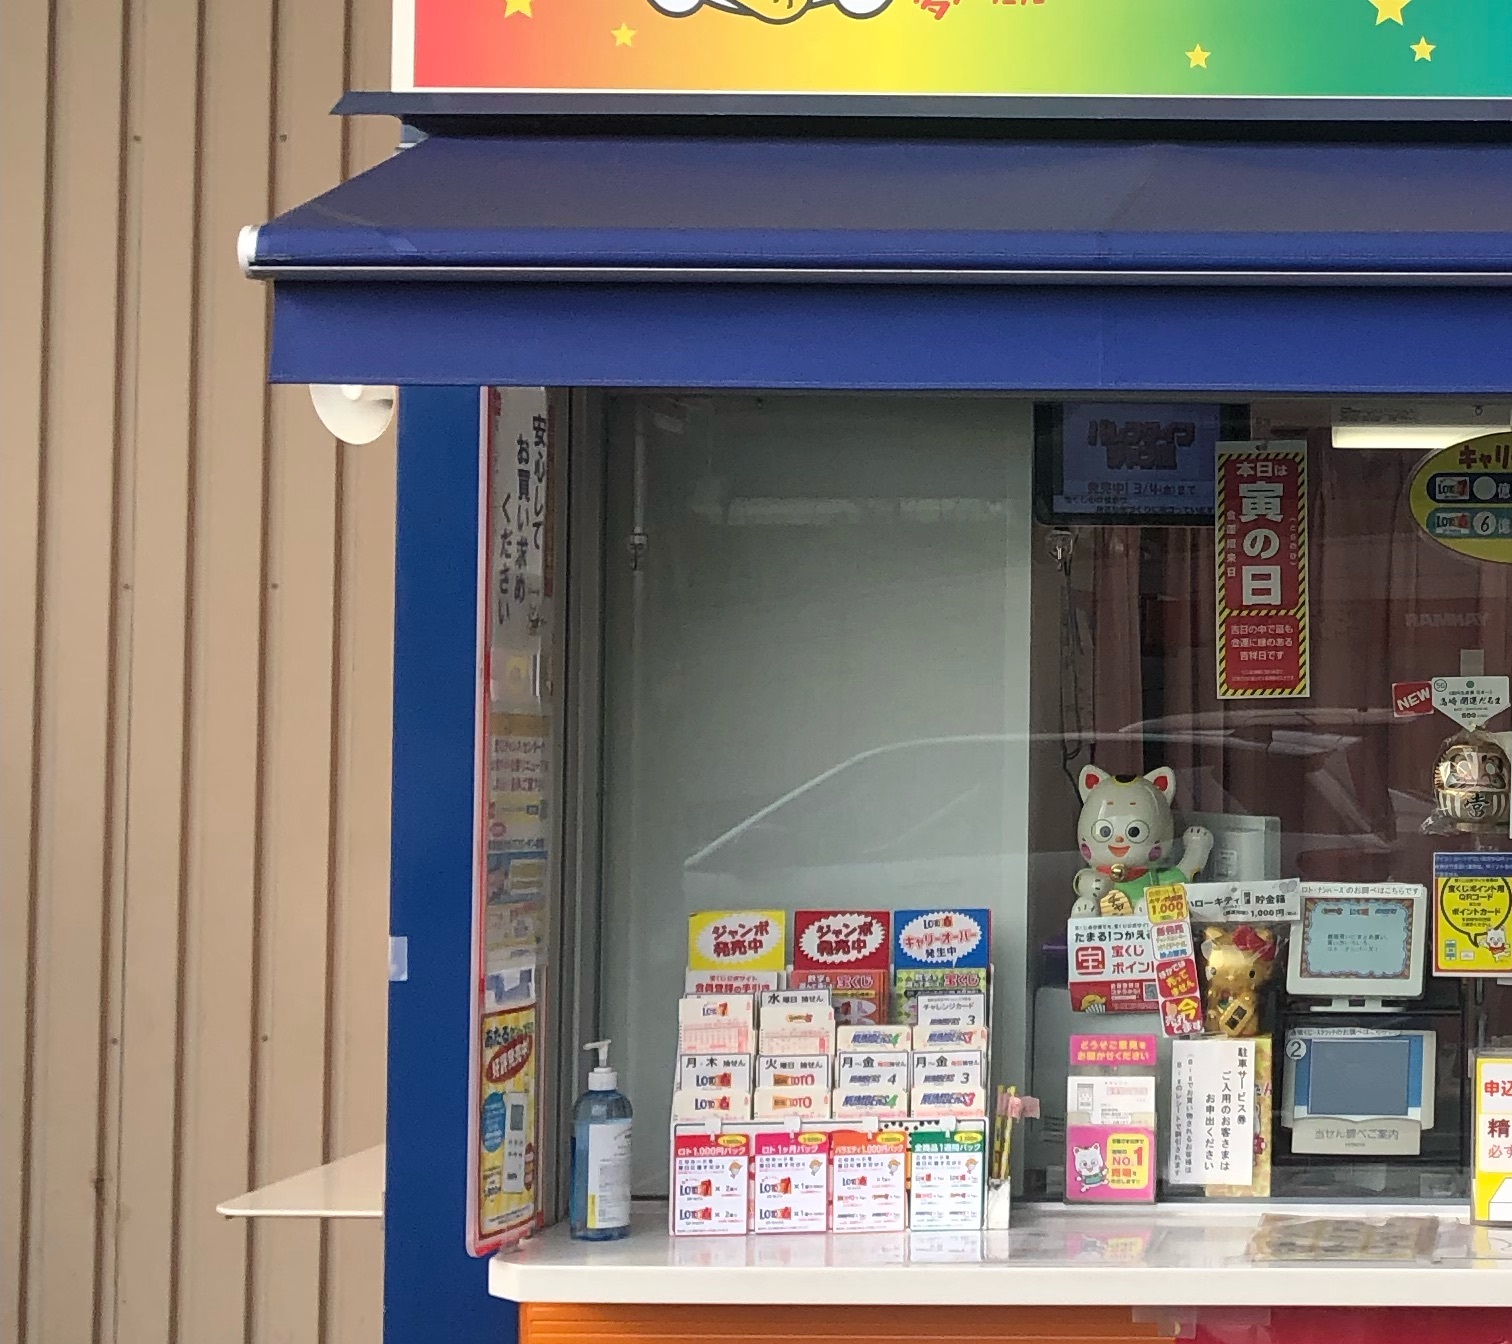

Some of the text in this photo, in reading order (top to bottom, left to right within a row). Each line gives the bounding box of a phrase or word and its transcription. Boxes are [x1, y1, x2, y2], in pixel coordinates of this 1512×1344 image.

[1236, 461, 1289, 478] 本日は
[1238, 481, 1285, 606] 寅の日
[1396, 686, 1432, 712] NEW
[711, 920, 770, 941] ジャンボ
[815, 920, 874, 940] ジャンボ
[904, 930, 978, 950] キャリーオーバー
[713, 937, 764, 957] 発売中
[816, 937, 867, 957] 発売中
[925, 947, 957, 959] 発生中
[1111, 944, 1145, 958] 宝くじ
[1220, 1070, 1232, 1172] ご入用のお客さまは
[1204, 1093, 1216, 1171] お申出ください
